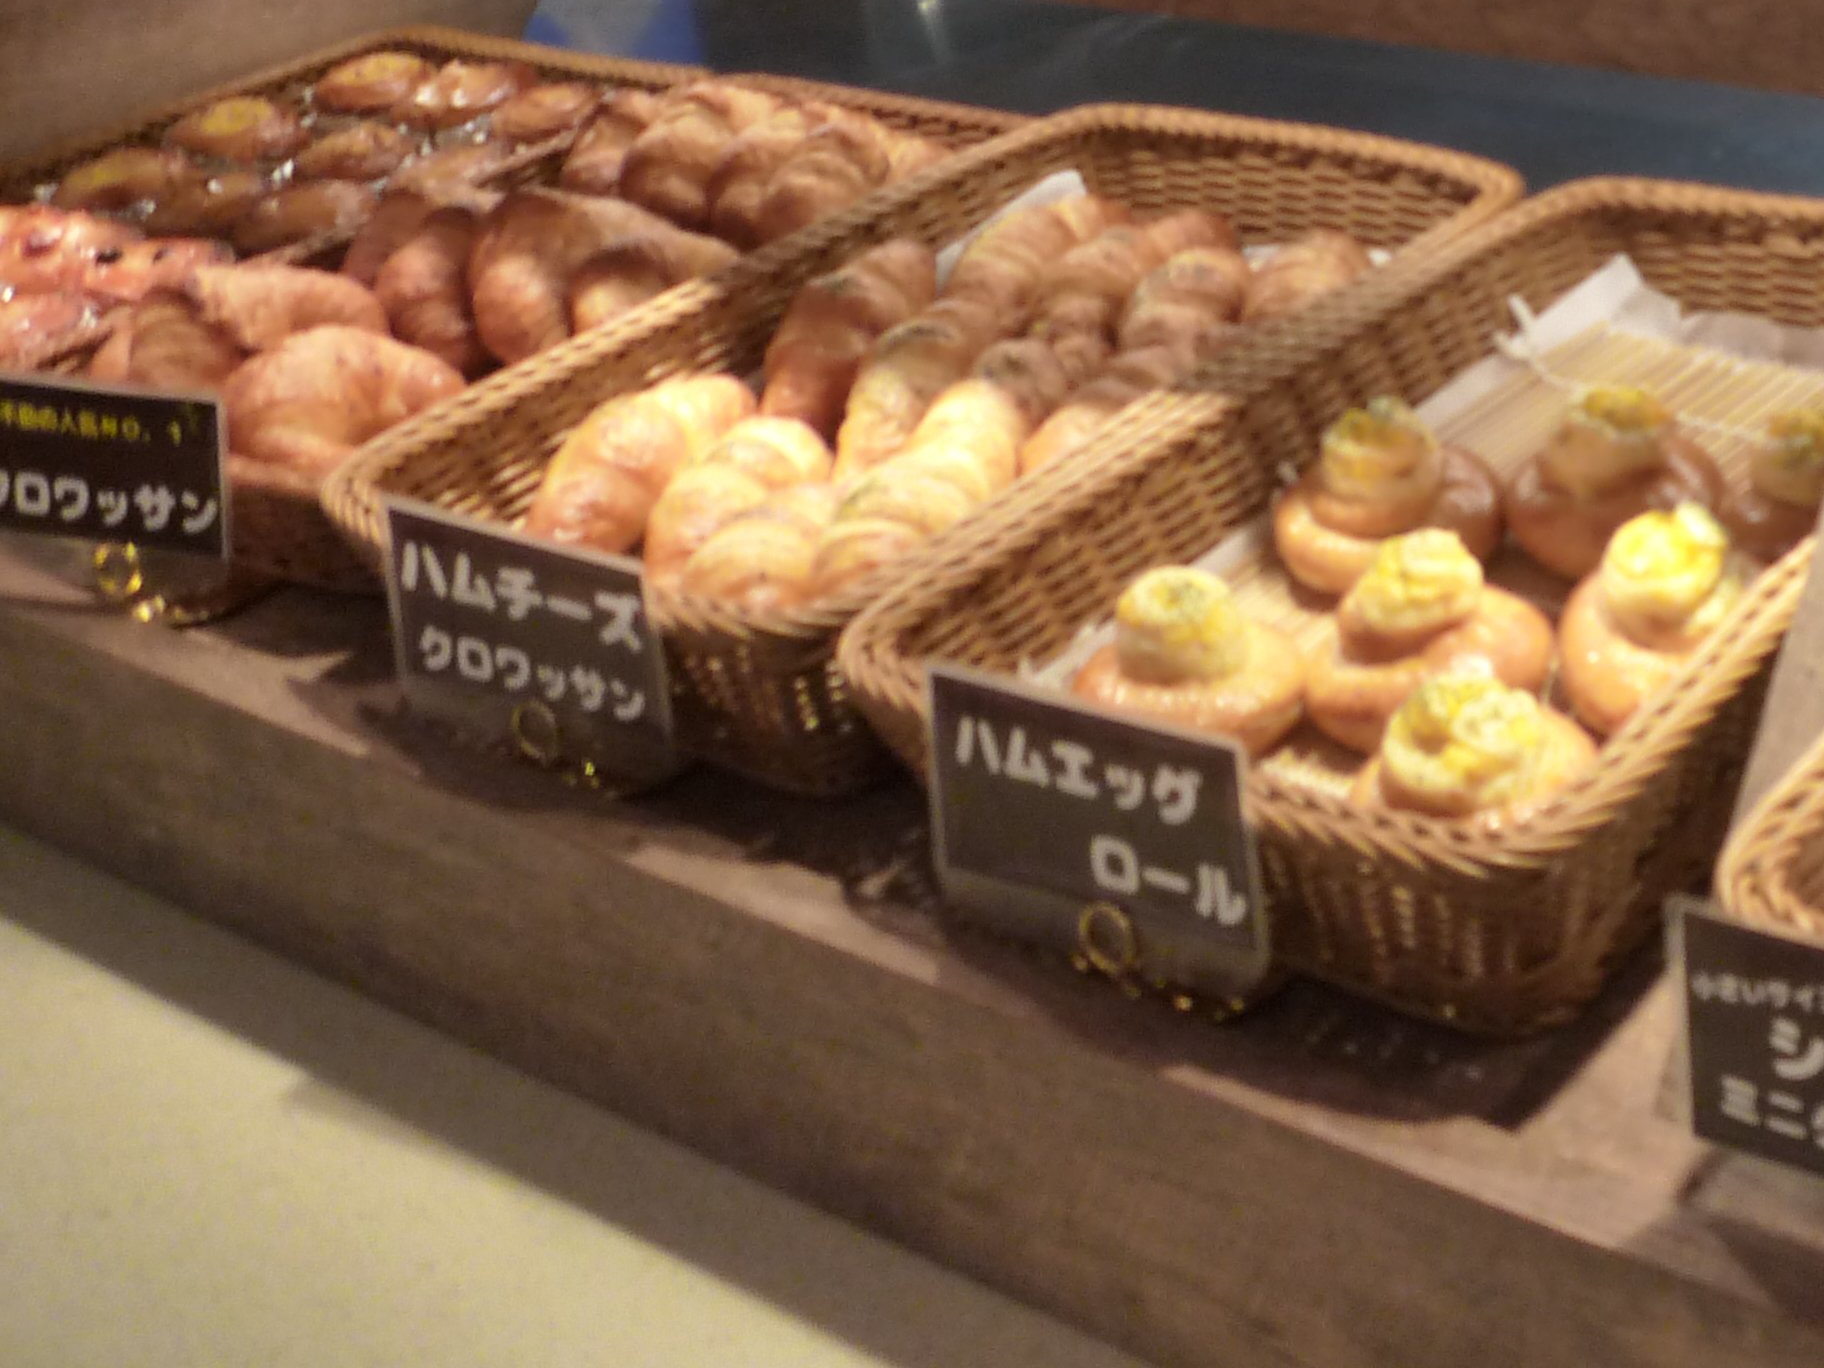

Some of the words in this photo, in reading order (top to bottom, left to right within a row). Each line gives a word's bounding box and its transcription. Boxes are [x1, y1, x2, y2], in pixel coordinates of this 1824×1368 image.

[0, 468, 218, 532] ロワッサン
[401, 540, 642, 654] ハムチーズ
[419, 625, 645, 721] クロワッサン
[955, 715, 1203, 825] ハムエッグ
[1090, 834, 1247, 926] ロール
